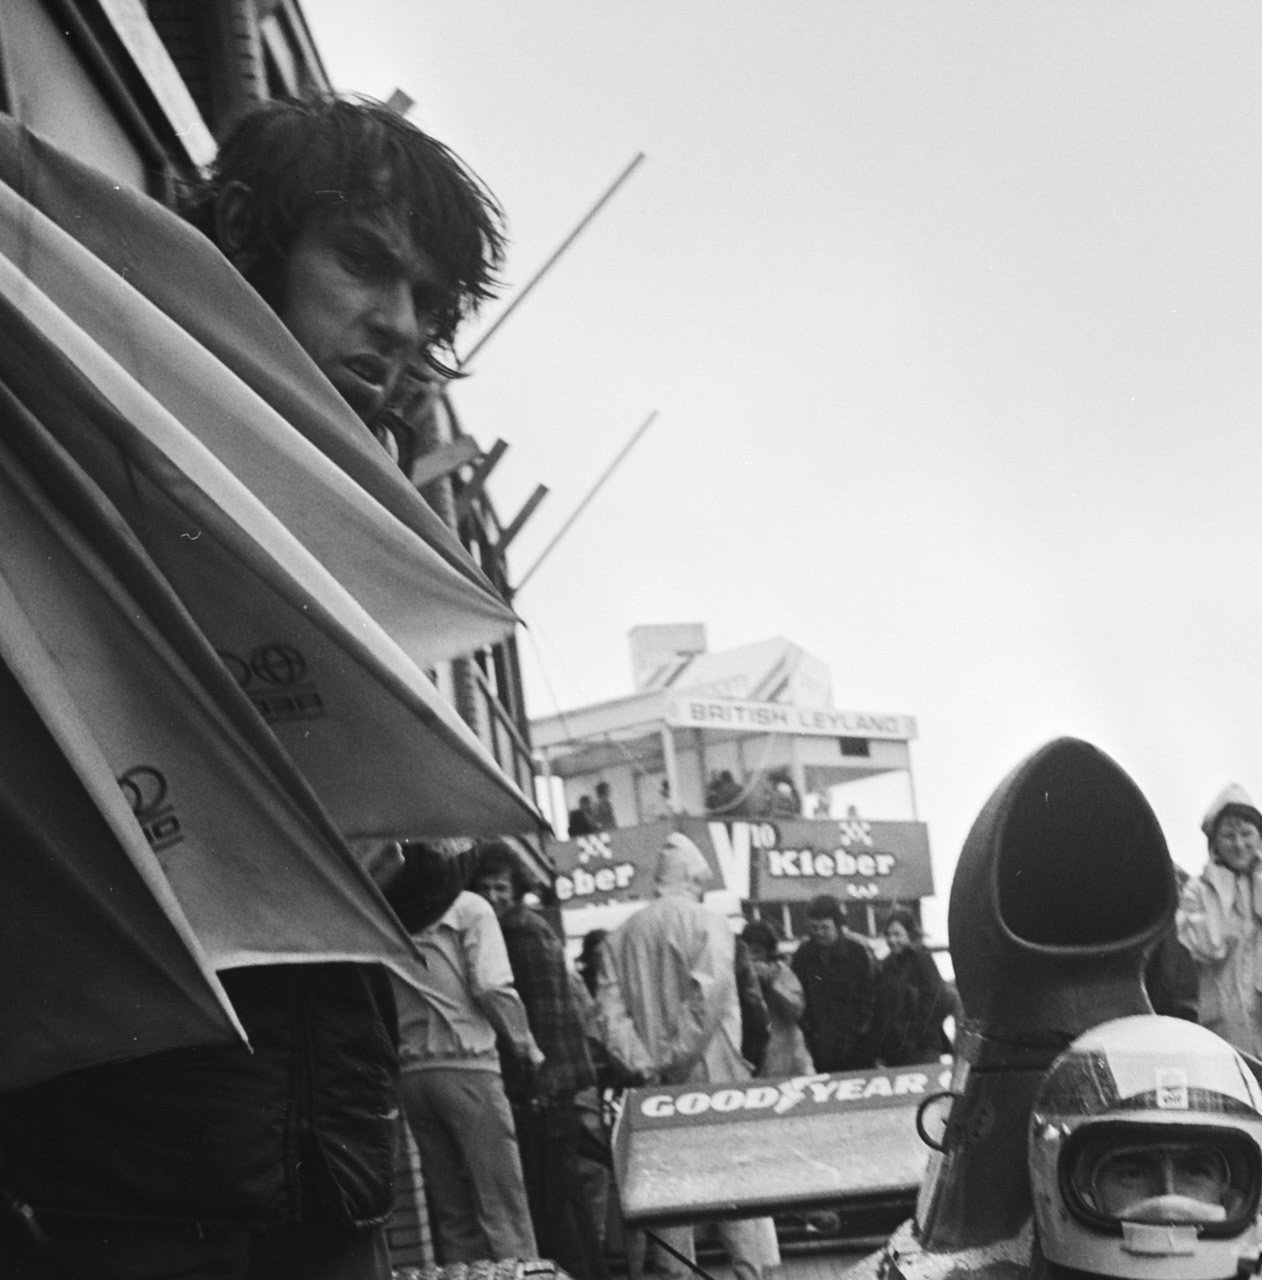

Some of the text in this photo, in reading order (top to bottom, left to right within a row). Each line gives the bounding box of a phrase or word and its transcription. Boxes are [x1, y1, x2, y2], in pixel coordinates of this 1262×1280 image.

[690, 703, 898, 733] BRITISH LEYLAND
[768, 848, 896, 877] Kleber
[555, 862, 635, 900] eber
[641, 1072, 929, 1117] GOODYEAR
